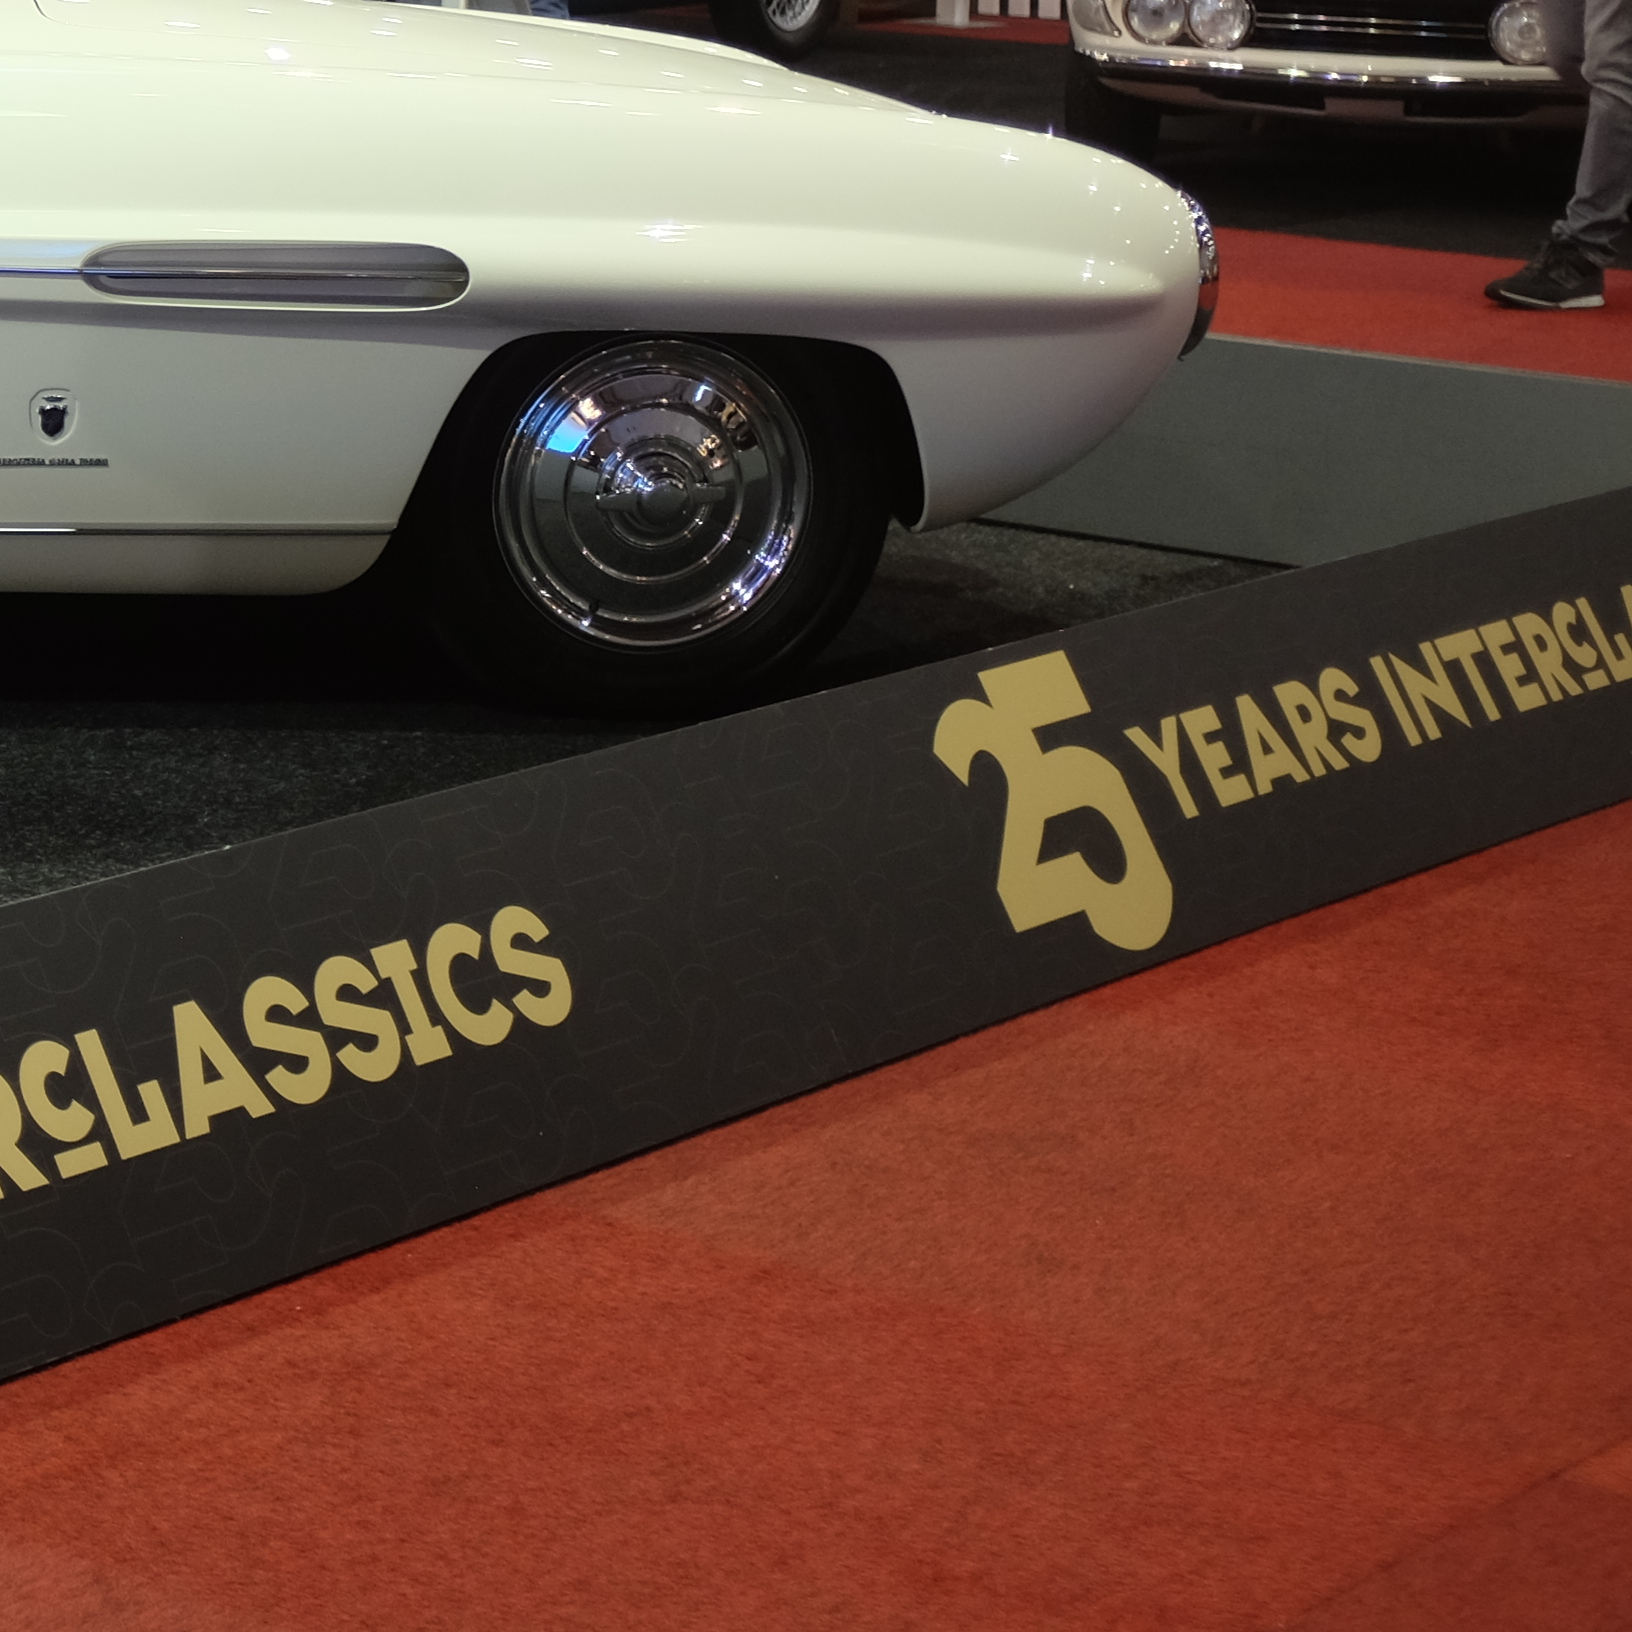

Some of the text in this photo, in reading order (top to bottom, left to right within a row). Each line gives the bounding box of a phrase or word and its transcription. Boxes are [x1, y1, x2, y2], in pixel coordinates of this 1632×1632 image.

[933, 585, 1632, 951] 25 YEARS INTERCL
